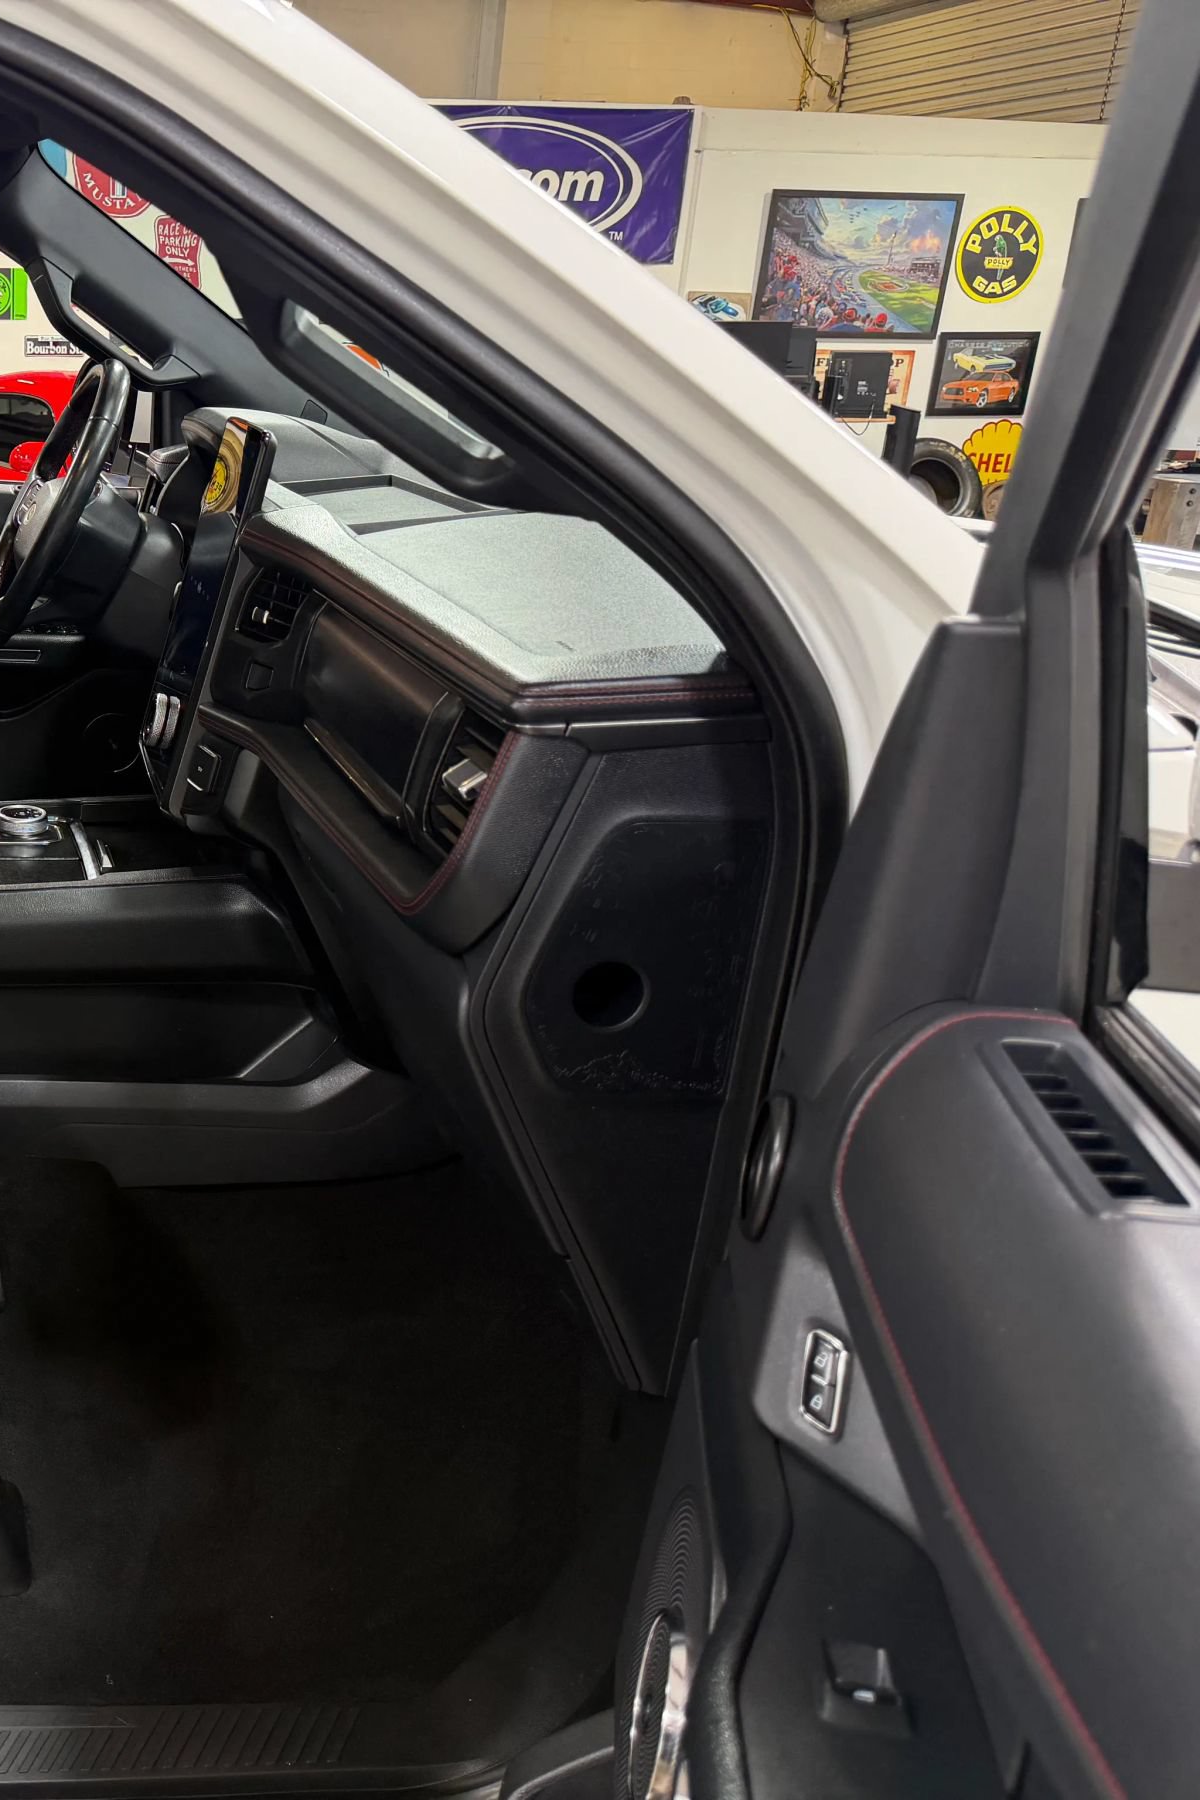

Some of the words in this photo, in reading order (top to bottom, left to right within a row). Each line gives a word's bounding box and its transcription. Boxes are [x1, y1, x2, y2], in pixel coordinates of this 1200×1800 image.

[158, 222, 181, 236] RACE
[965, 213, 1038, 255] POLLY
[159, 234, 198, 248] PARKING
[165, 246, 190, 257] ONLY
[987, 258, 1011, 266] POLLY
[972, 275, 1018, 294] GAS
[26, 341, 68, 354] Bourbon
[968, 452, 1012, 474] HEL
